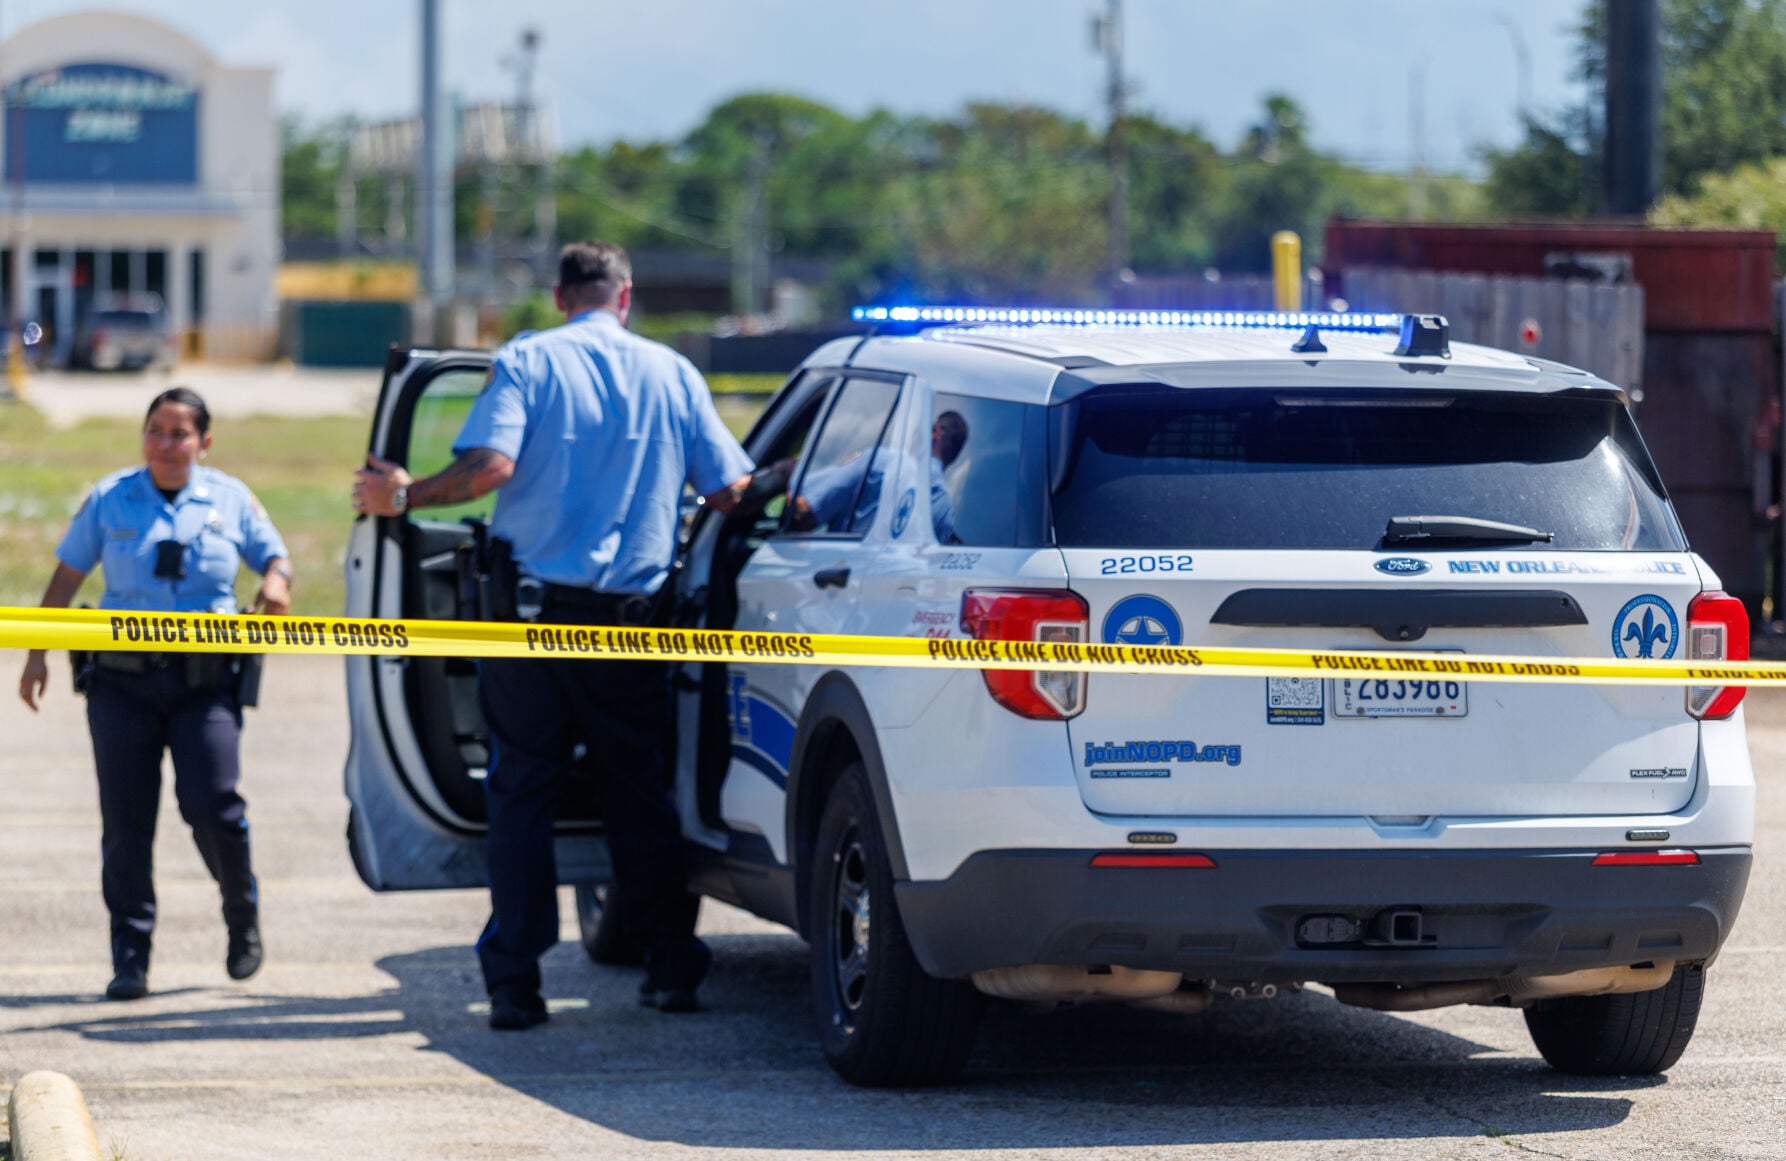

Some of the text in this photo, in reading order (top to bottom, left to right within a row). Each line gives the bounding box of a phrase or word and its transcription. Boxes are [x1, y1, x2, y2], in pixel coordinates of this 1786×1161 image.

[1101, 555, 1194, 575] 22052
[1387, 559, 1419, 571] Ford
[1447, 560, 1500, 574] NEW
[111, 616, 409, 648] POLICE LINE DO NOT CROSS
[526, 628, 815, 657] POLICE LINE DO NOT CROSS
[928, 639, 1203, 667] POLICE LINE DO NOT CROSS
[1312, 655, 1383, 670] POLICE
[1388, 657, 1429, 672] LINE
[1085, 741, 1241, 767] joinNOPD.org
